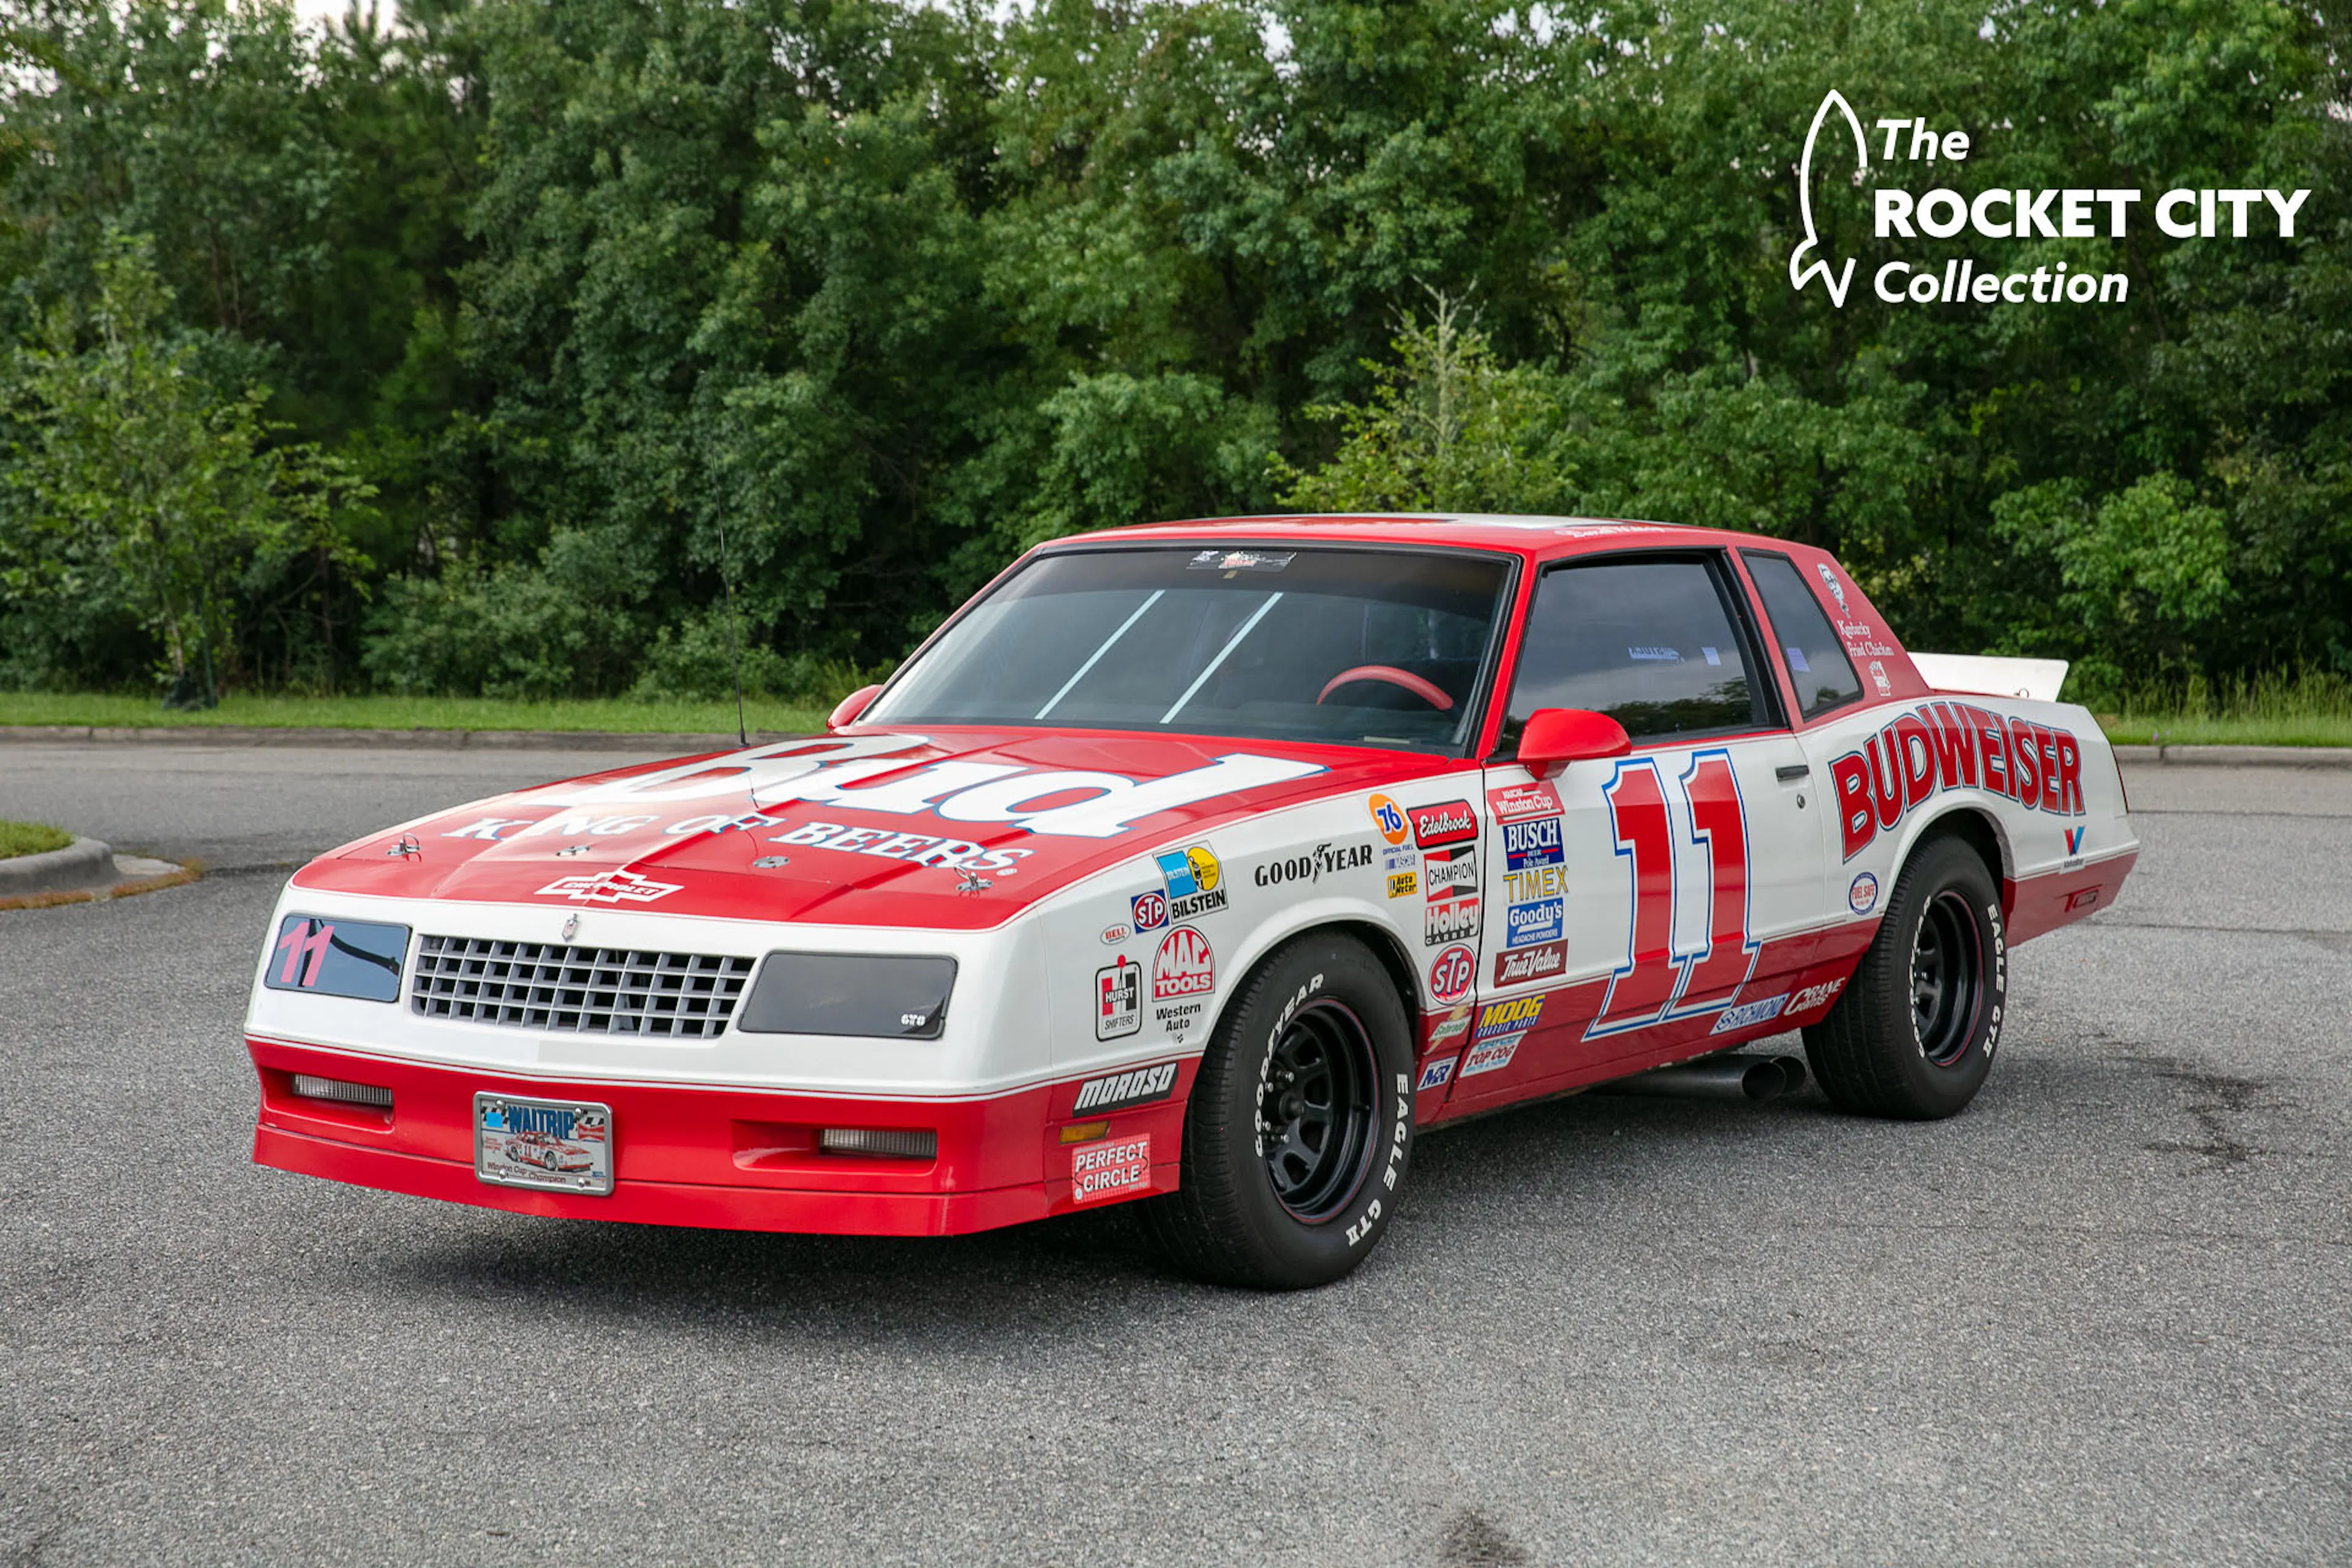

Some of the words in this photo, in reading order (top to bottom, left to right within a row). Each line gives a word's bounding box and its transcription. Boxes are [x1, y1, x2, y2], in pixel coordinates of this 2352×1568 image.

[1828, 701, 2086, 865] BUDWEISER
[1376, 804, 1402, 833] 76
[1496, 797, 1536, 814] Winston
[1533, 795, 1553, 809] Cup
[1419, 810, 1472, 839] Edelbrock
[1507, 819, 1559, 852] BUSCH
[767, 822, 1036, 870] BEERS
[1255, 843, 1372, 887] GOODYEAR
[1428, 862, 1474, 886] CHAMPION
[563, 881, 660, 895] CHEVROLET
[1503, 864, 1568, 903] TIMEX
[1581, 748, 1762, 1043] 11
[1137, 897, 1164, 925] STP
[1172, 889, 1226, 919] BILSTEIN
[1426, 902, 1478, 937] Holley
[1509, 901, 1562, 927] Goody's
[1425, 930, 1466, 944] CARBS
[1987, 903, 2004, 992] EAGLE
[279, 921, 334, 987] 11
[1156, 930, 1212, 980] MAC
[1156, 974, 1211, 996] TOOLS
[1433, 950, 1471, 995] STP
[1105, 987, 1134, 1004] HURST
[1104, 1014, 1134, 1031] SHIFTERS
[1156, 1003, 1200, 1020] Western
[1166, 1019, 1190, 1032] Auto
[1479, 994, 1545, 1029] MOOG
[1074, 1062, 1177, 1110] MOROSO
[1254, 973, 1324, 1158] GOODYEAR
[1382, 1072, 1409, 1191] EAGLE
[1075, 1141, 1148, 1174] PERFECT
[1084, 1164, 1140, 1193] CIRCLE
